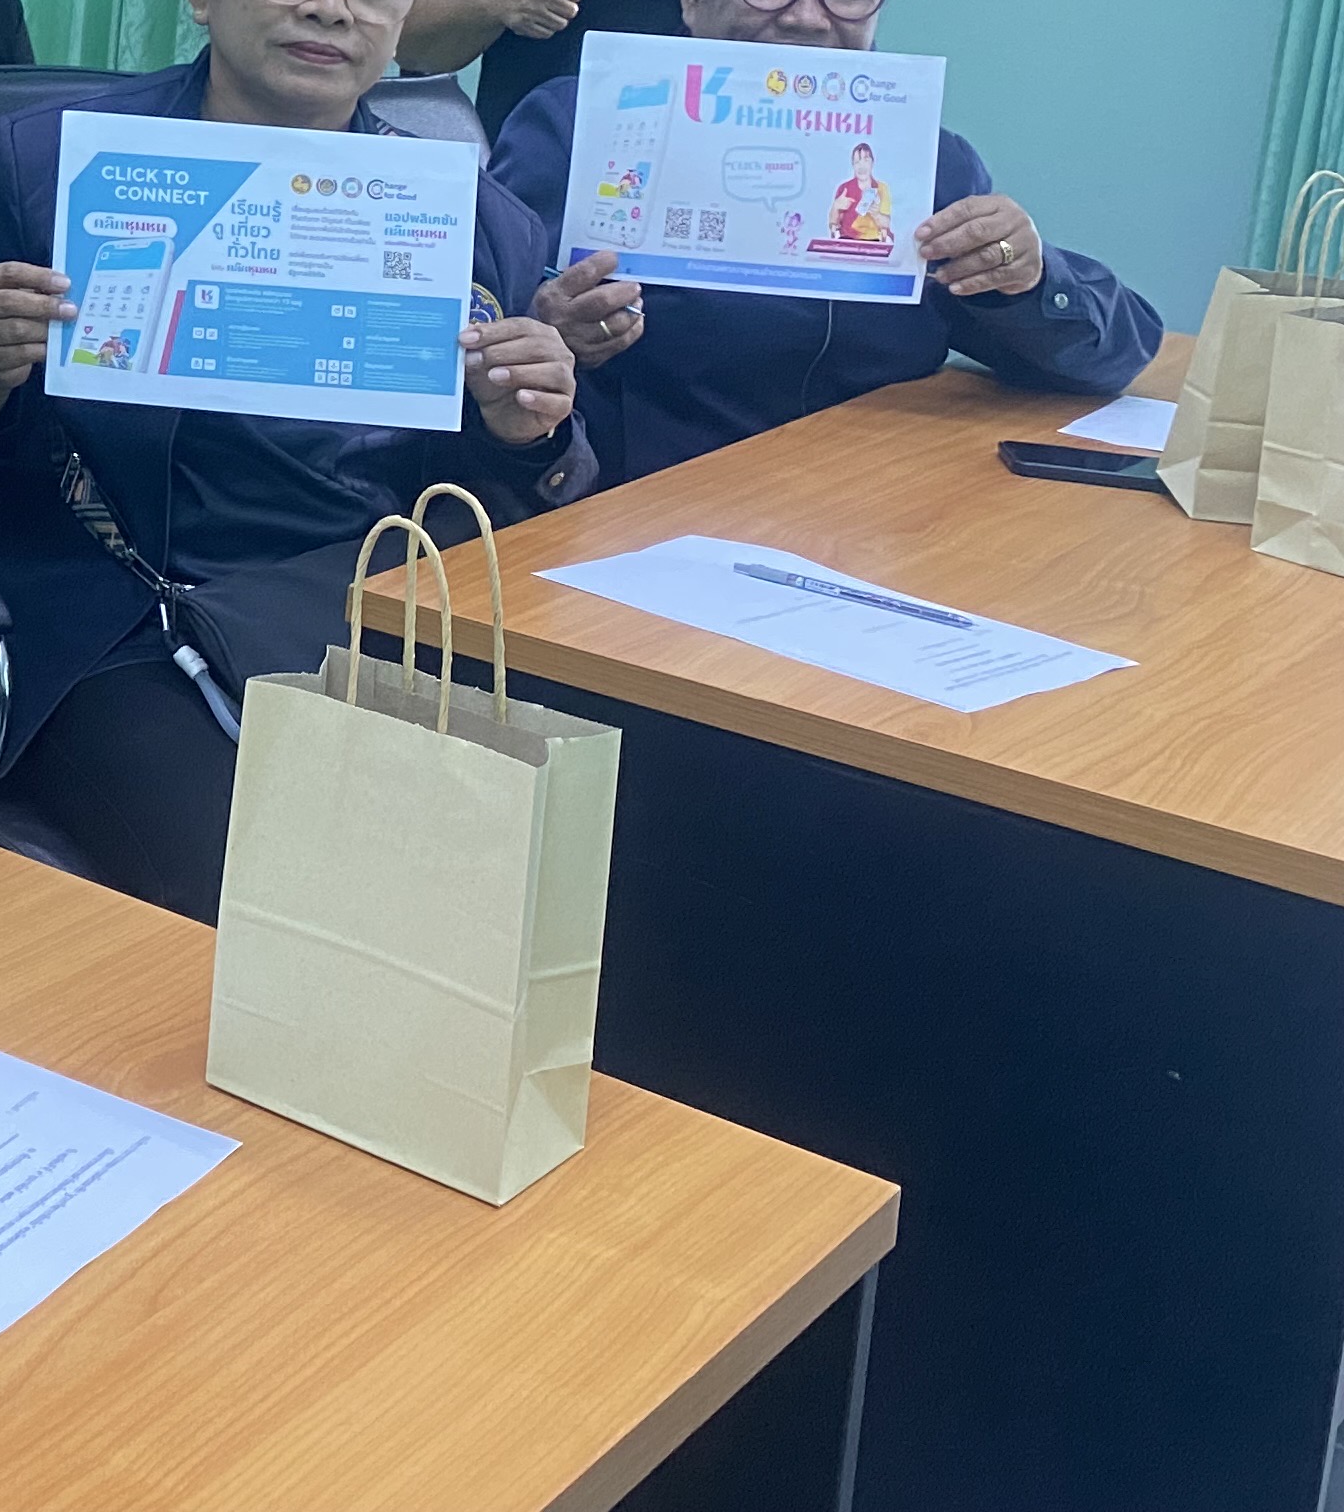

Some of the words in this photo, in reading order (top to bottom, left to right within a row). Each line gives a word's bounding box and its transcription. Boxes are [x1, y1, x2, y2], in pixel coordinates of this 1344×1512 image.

[735, 98, 874, 137] คลิกชุมชน
[101, 165, 159, 183] CLICK
[163, 170, 190, 185] TO
[114, 185, 209, 206] CONNECT
[231, 199, 282, 223] เรียนรู้
[93, 216, 167, 235] คลิกชุมชน
[212, 222, 224, 240] ดู
[231, 216, 271, 239] เที่ยว
[227, 238, 281, 261] ทั่วไทย
